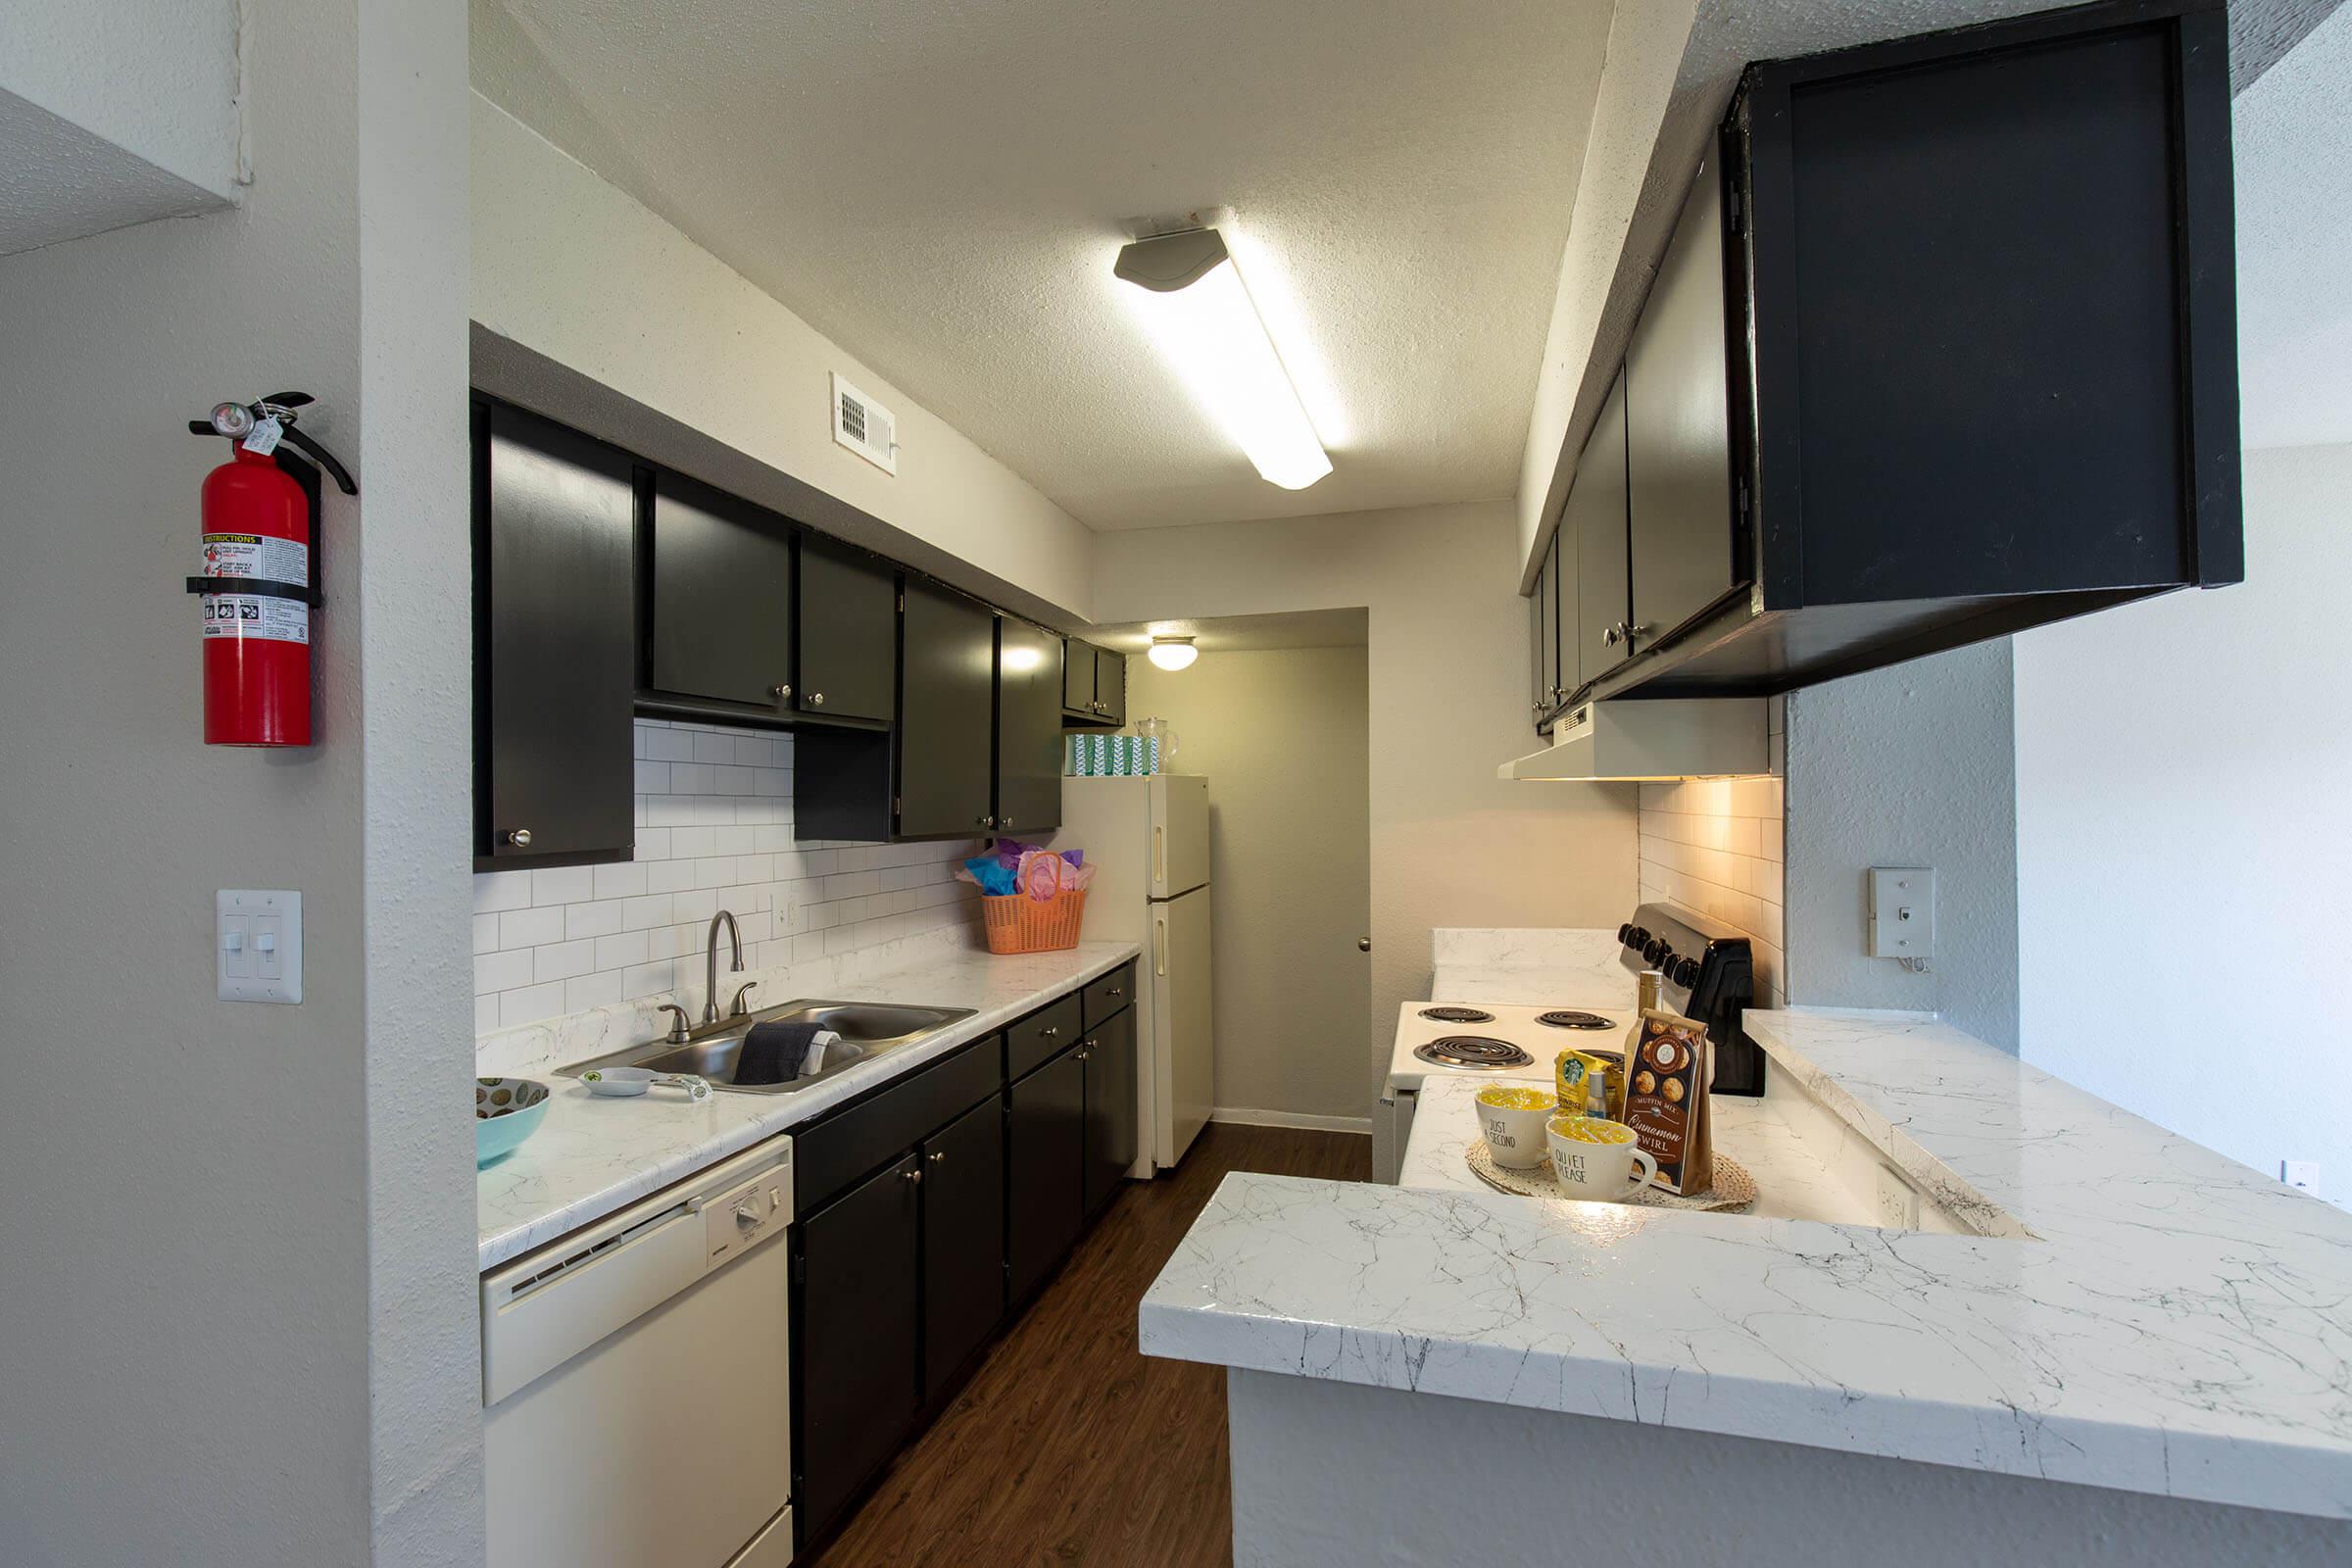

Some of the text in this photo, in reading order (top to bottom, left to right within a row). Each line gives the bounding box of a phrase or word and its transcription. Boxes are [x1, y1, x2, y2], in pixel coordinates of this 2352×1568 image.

[1638, 1097, 1677, 1113] MUFFIN MIX
[1490, 1118, 1505, 1134] JUST
[1628, 1113, 1682, 1143] Cinnamon
[1490, 1132, 1516, 1148] SECOND
[1555, 1149, 1585, 1169] QUIET
[1558, 1163, 1588, 1184] PLEASE
